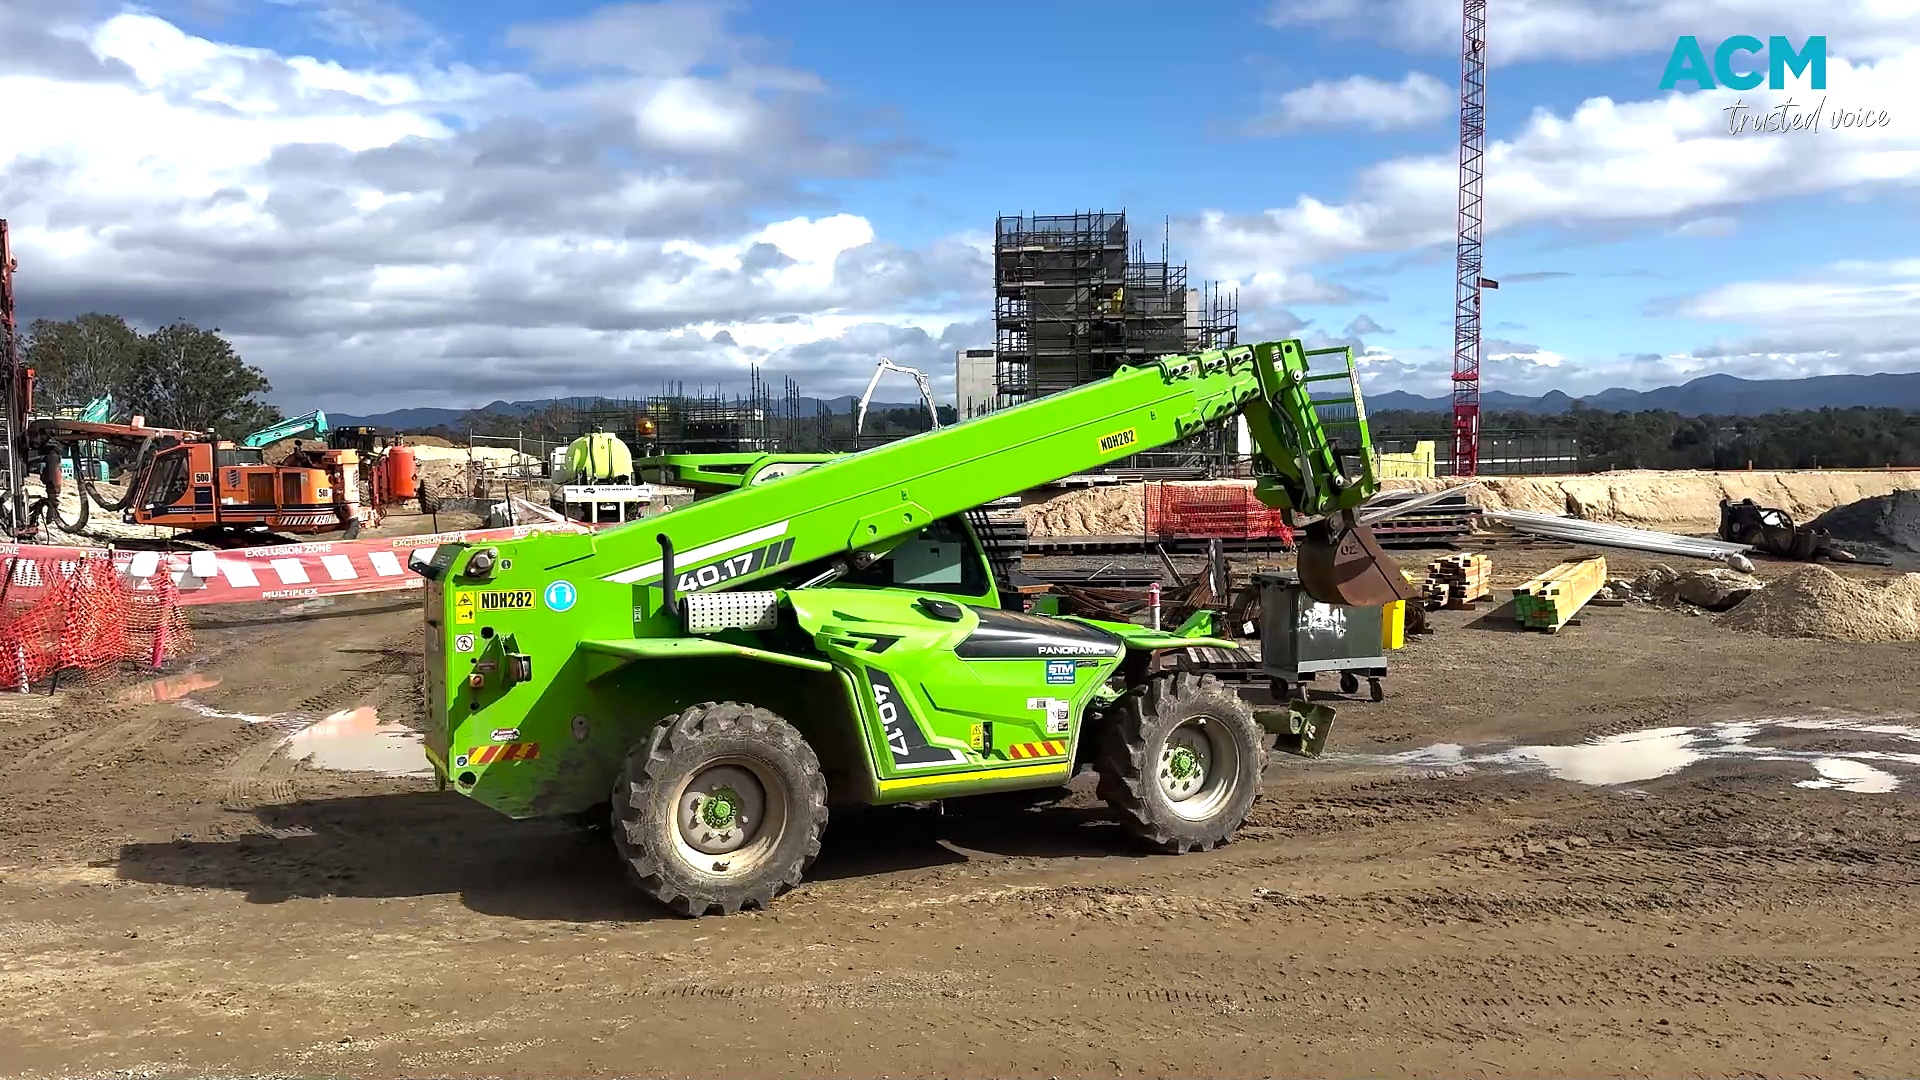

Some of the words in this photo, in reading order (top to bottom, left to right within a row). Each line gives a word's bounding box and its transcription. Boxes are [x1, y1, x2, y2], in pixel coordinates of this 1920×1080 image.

[1100, 429, 1135, 452] NDH282
[195, 473, 210, 482] 500
[0, 545, 20, 555] ONE
[245, 545, 303, 558] EXCLUSION
[305, 544, 332, 554] ZONE
[676, 552, 754, 592] 40.17
[262, 587, 318, 598] MULTIPLEX
[481, 591, 532, 609] NDH282
[1037, 646, 1106, 655] PANORAMIC
[1048, 663, 1074, 674] STM
[873, 683, 910, 756] 40.17
